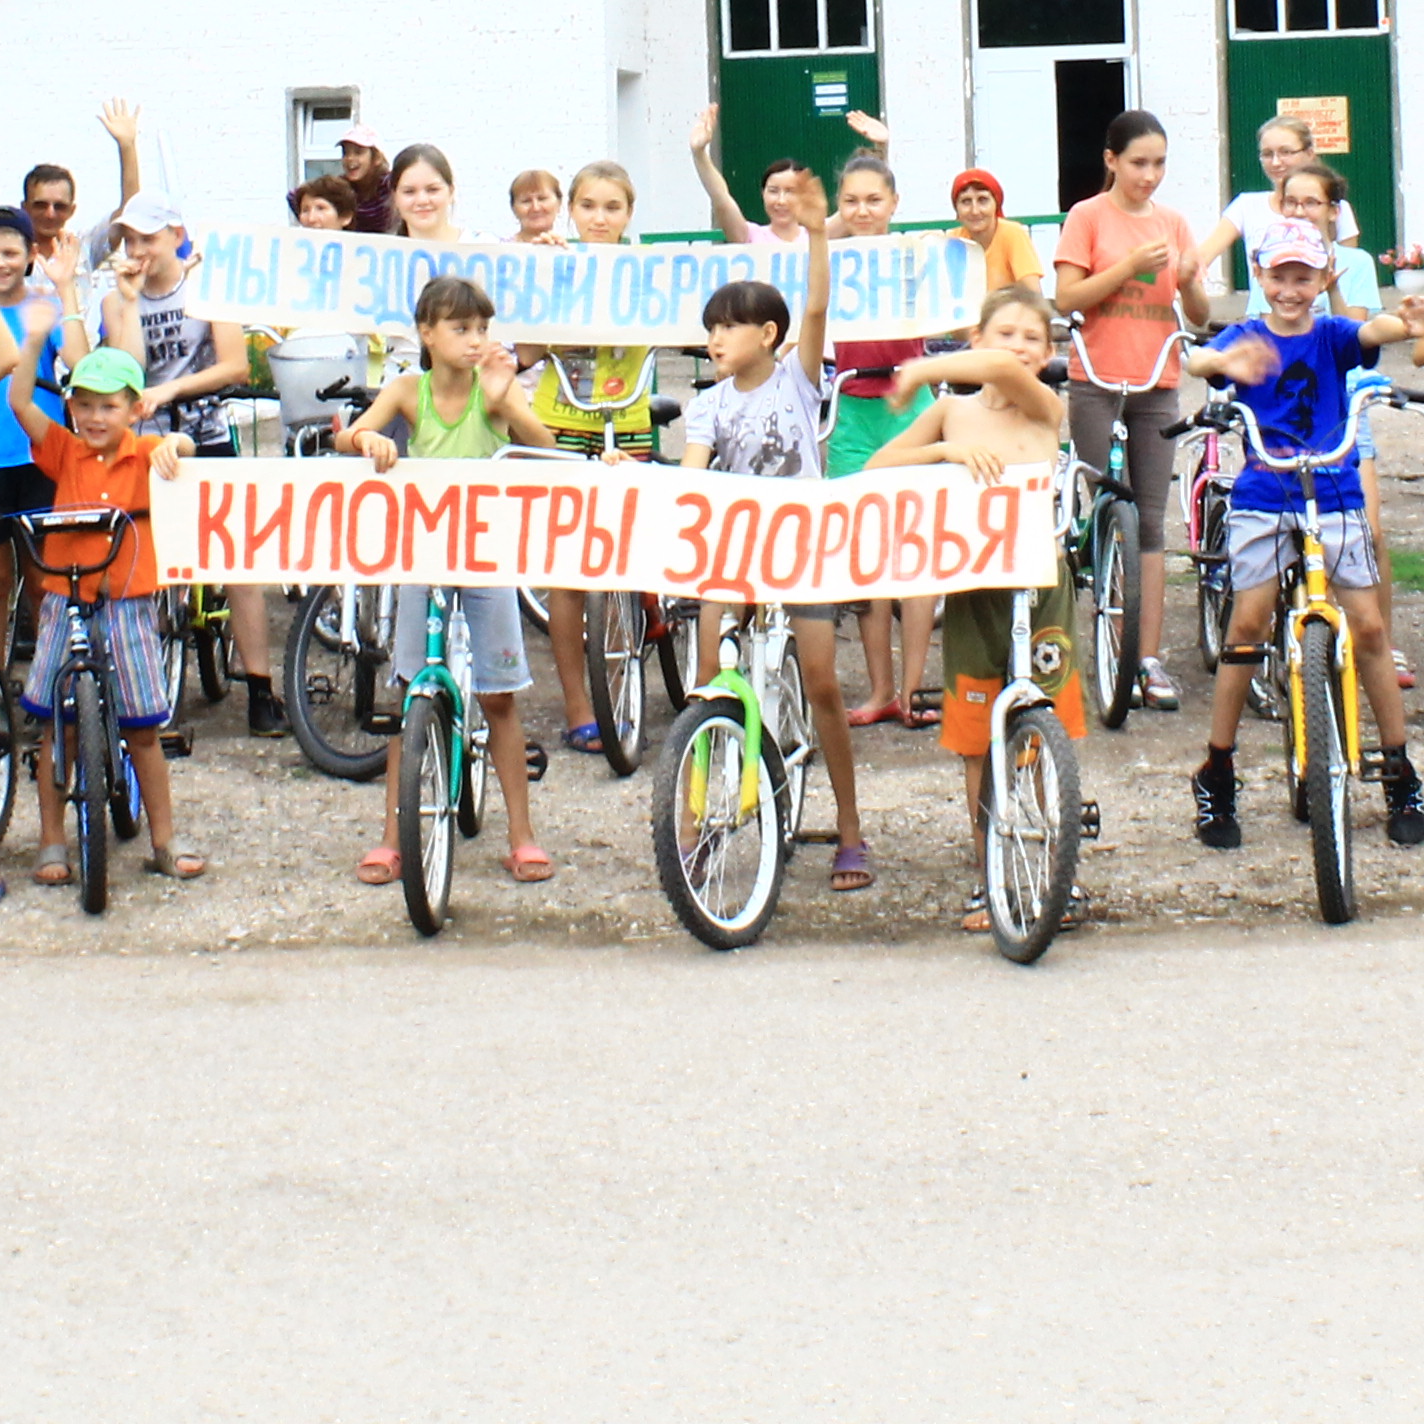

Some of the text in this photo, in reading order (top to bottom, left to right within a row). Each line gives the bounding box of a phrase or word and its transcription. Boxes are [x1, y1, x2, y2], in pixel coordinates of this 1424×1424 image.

[199, 230, 281, 307] МЫ
[289, 238, 344, 313] ЗА
[770, 238, 969, 323] ЖЗНИ!
[142, 308, 189, 327] VENTU
